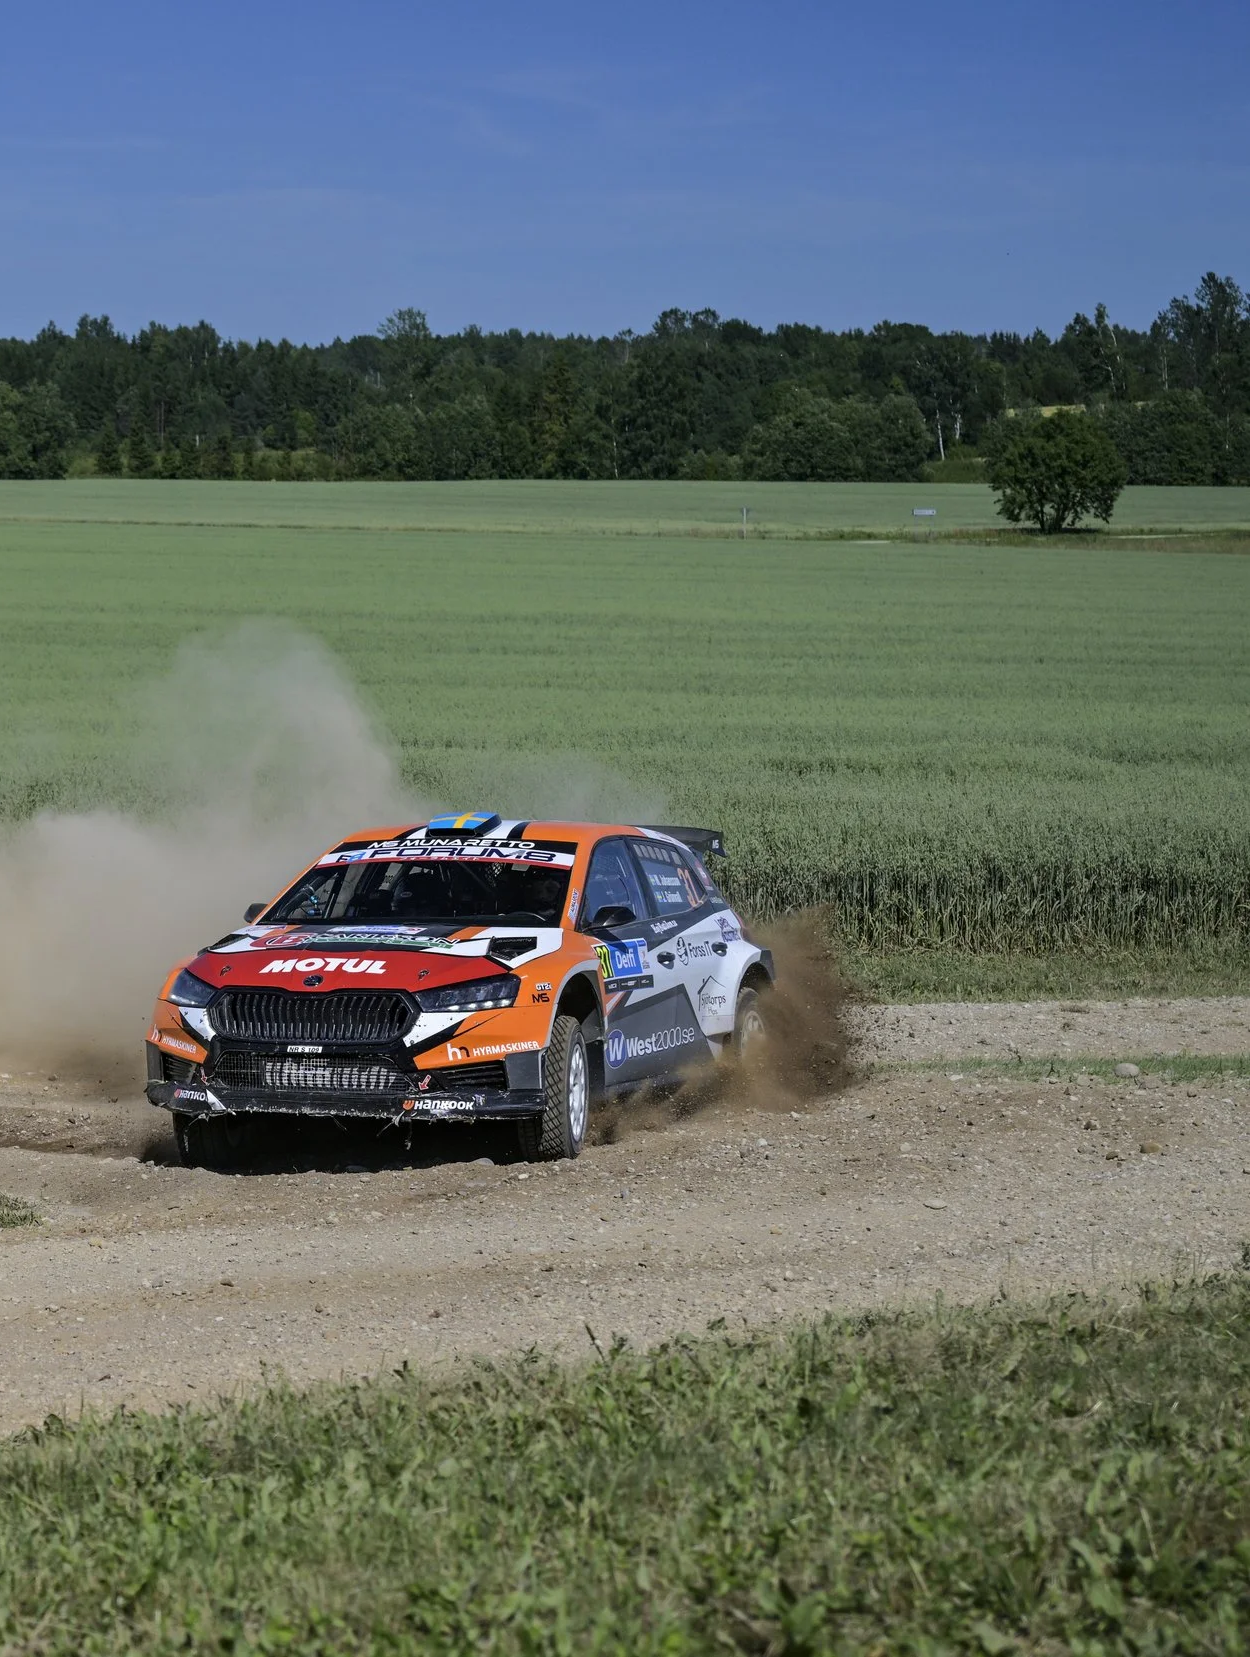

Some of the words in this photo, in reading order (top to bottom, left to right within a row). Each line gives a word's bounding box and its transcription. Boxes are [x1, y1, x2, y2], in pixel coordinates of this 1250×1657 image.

[399, 838, 536, 849] MUNARETTO
[369, 847, 557, 862] FORUM8
[258, 957, 388, 974] MOTUL
[595, 945, 614, 979] 31
[472, 1040, 540, 1057] HYRMASKINER
[625, 1026, 695, 1058] West2000.se
